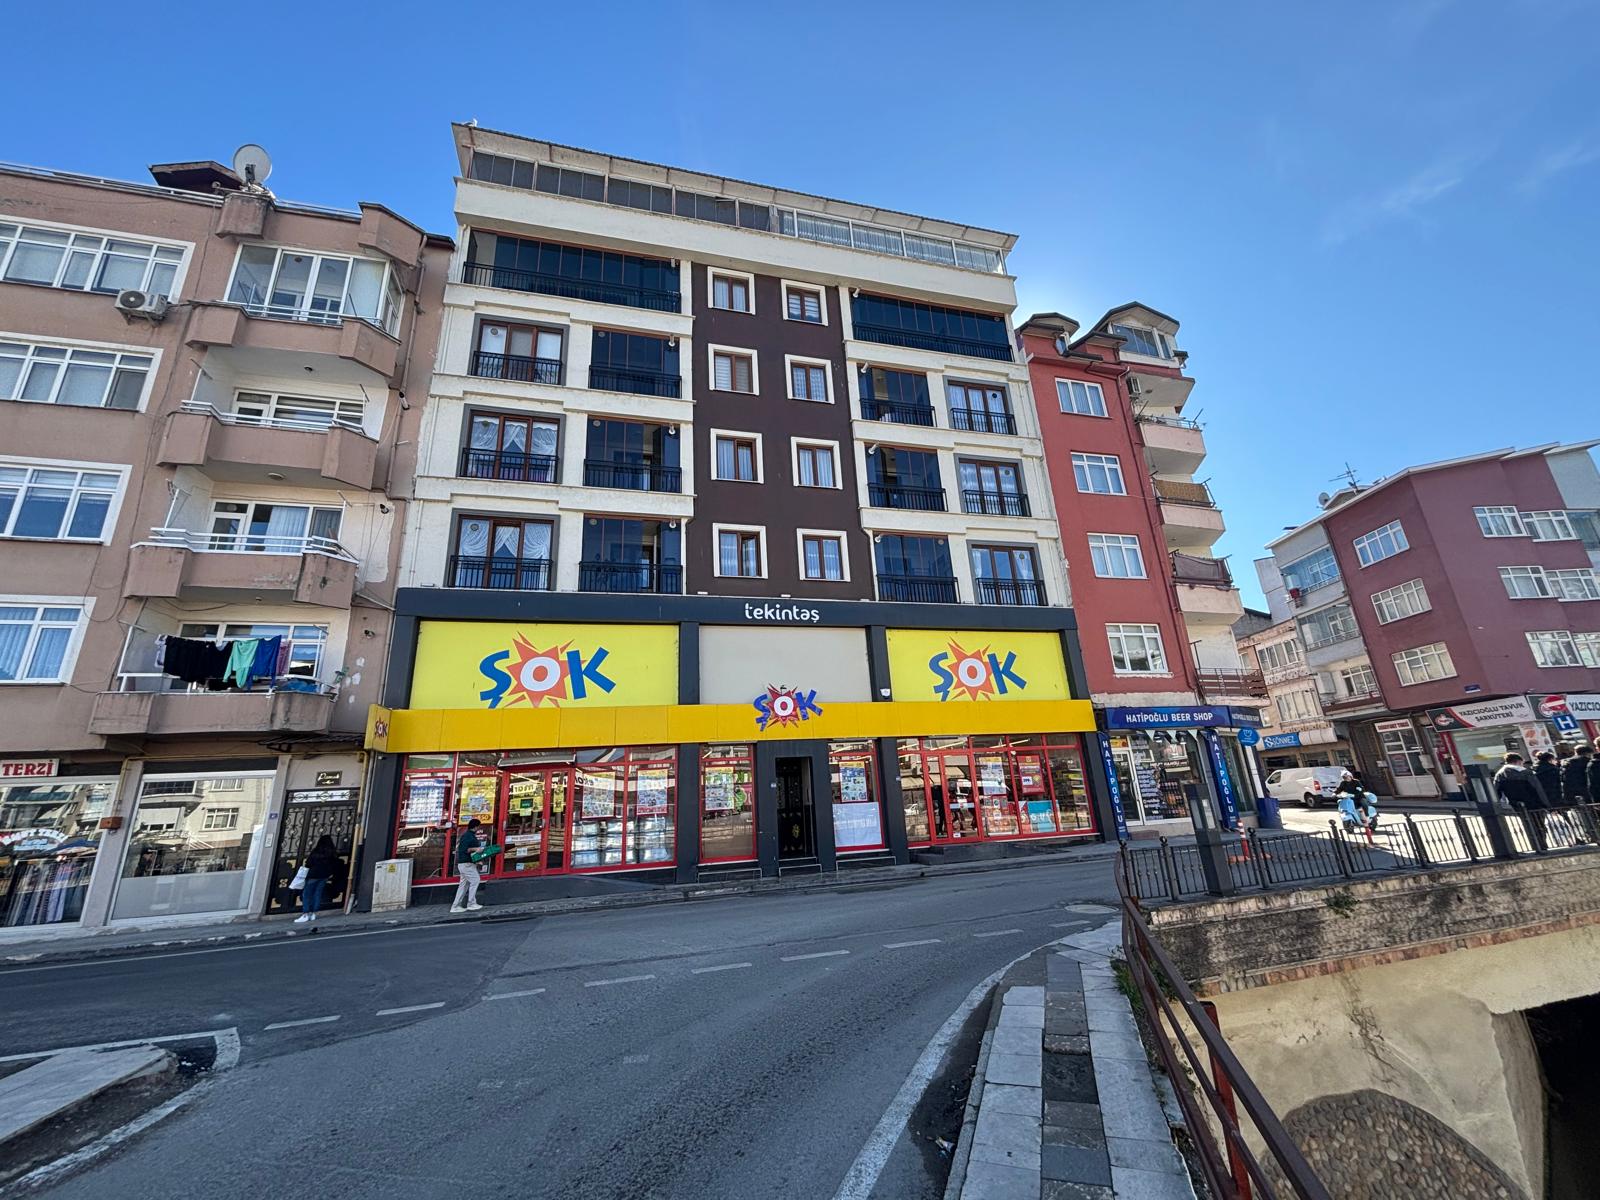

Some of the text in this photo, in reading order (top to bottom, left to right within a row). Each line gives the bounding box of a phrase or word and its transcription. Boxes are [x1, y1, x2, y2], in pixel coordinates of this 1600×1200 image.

[744, 602, 820, 623] tekintaş
[479, 646, 617, 709] ŞOK
[928, 650, 1028, 702] ŞOK
[753, 689, 823, 732] ŞOK
[1499, 702, 1525, 711] TAVUK
[1125, 712, 1213, 723] HATİPOĞLU BEER SHOP
[1557, 715, 1574, 729] H
[2, 759, 54, 776] TERZİ
